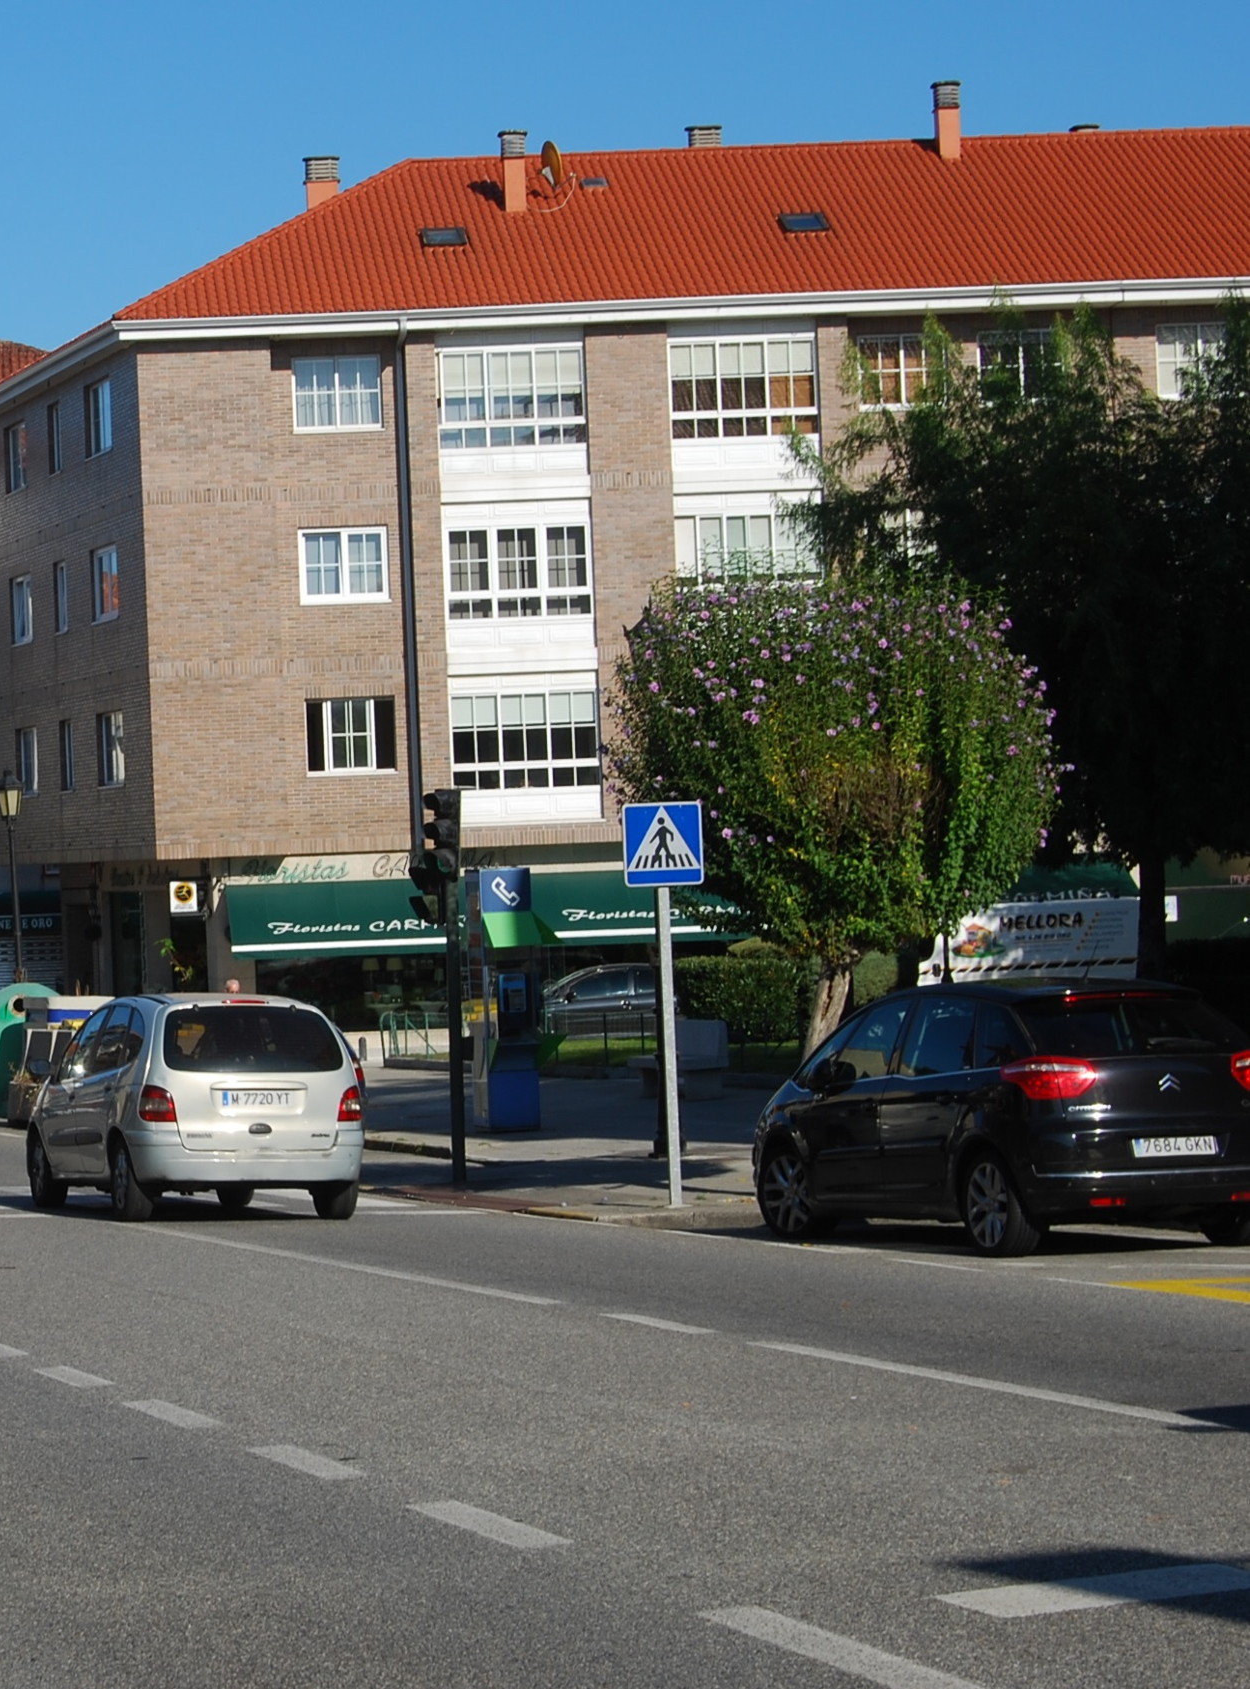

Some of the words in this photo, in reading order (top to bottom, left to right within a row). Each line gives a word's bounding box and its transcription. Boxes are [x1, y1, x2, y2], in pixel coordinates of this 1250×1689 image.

[562, 908, 655, 922] Floristas
[1000, 911, 1084, 932] MELLORA
[31, 918, 53, 928] ORO
[267, 921, 361, 935] Floristas
[231, 1093, 239, 1105] M
[243, 1093, 273, 1105] 7720
[276, 1093, 290, 1104] YT
[1143, 1138, 1181, 1153] 7684
[1184, 1136, 1213, 1151] GKN
